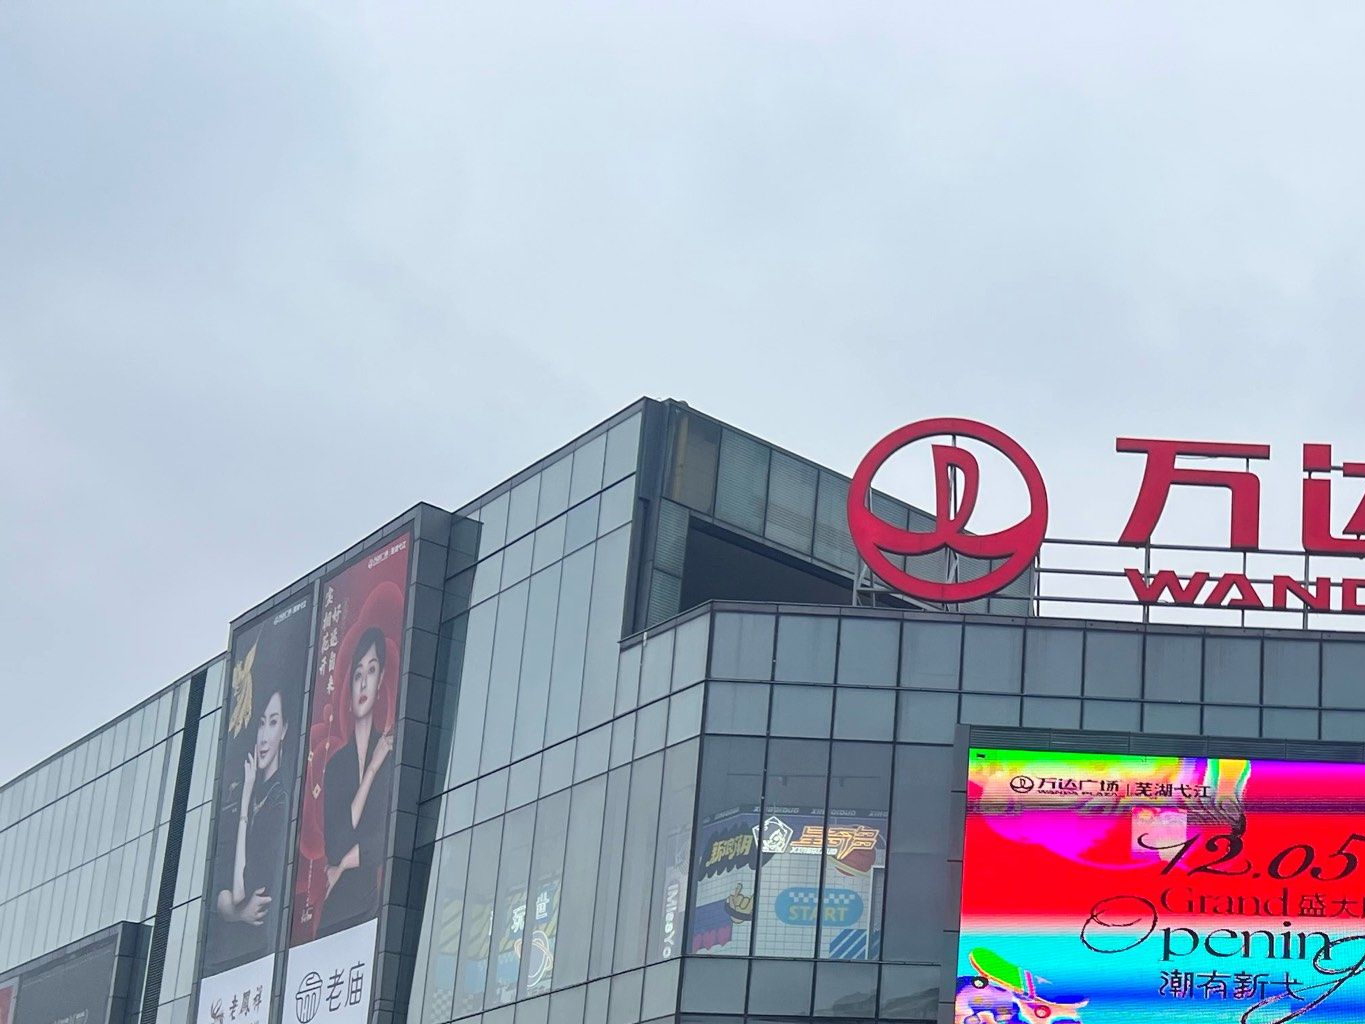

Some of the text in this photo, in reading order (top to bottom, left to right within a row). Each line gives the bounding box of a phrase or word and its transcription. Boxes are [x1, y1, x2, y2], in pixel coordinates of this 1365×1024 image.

[1037, 777, 1211, 799] 万达广场 芜湖弋江
[788, 905, 848, 921] START
[1160, 887, 1290, 917] Grand
[326, 961, 365, 1012] 老庙
